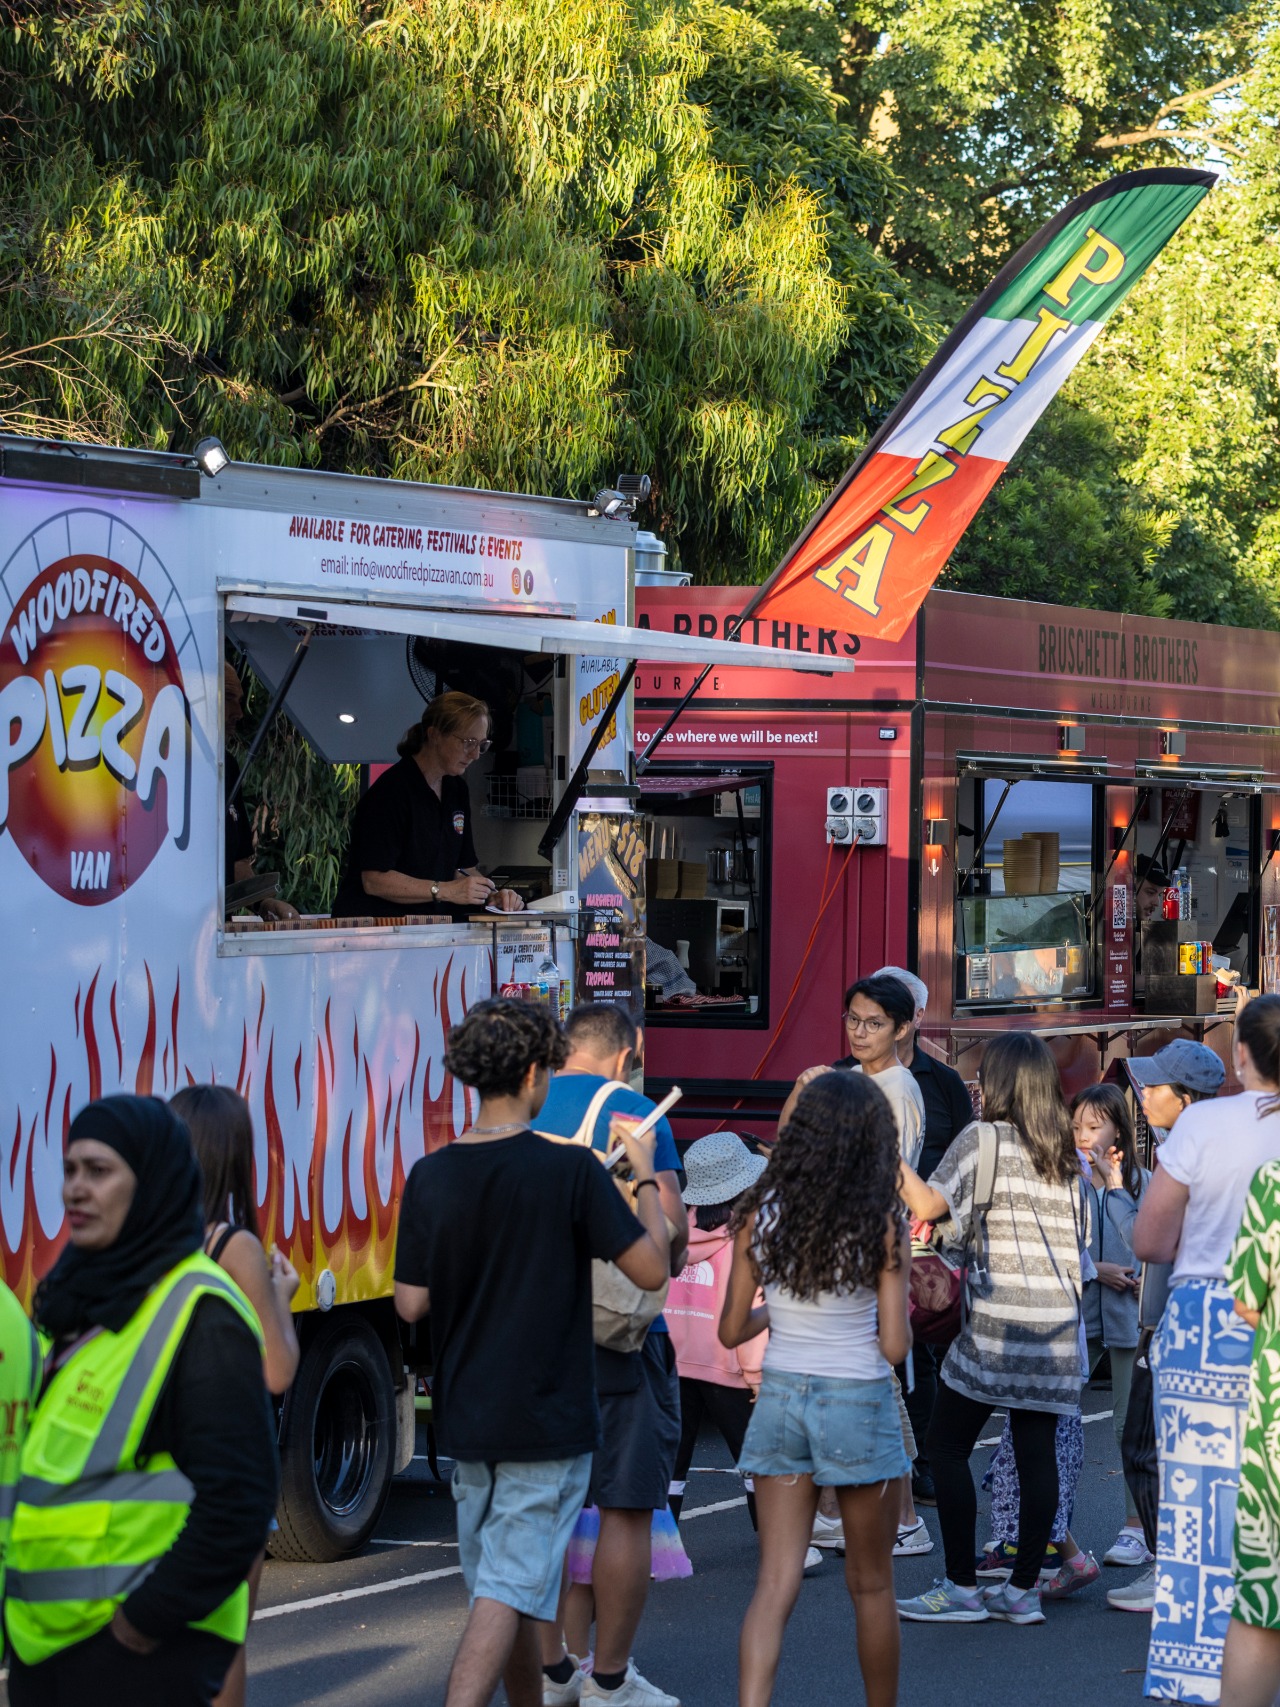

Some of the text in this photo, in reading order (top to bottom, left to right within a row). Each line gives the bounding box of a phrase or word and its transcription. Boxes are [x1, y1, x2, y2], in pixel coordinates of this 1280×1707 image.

[813, 224, 1128, 618] PIZZA
[288, 515, 523, 561] AVAILABLE FOR CATERING, FESTIVALS & EVENTS
[320, 555, 494, 588] email: info@woodfiredpizzavan.com.au
[10, 567, 166, 665] WOODFIRED
[295, 629, 336, 637] WTCH
[674, 613, 861, 655] BROTHERS
[580, 658, 619, 673] AVAILABLE
[1038, 624, 1199, 684] BRUSCHETTA BROTHERS
[579, 670, 621, 727] GLUTEN
[1091, 692, 1151, 712] MELBOURNE
[637, 731, 651, 743] to
[675, 730, 717, 743] where
[719, 733, 738, 743] we
[740, 730, 763, 743] will
[766, 730, 782, 743] be
[784, 731, 819, 744] next!
[0, 664, 190, 851] PIZZA
[578, 817, 646, 882] MENU $18
[70, 850, 111, 890] VAN
[586, 893, 623, 907] MARGHERITA
[586, 933, 620, 947] AMERICANA
[514, 954, 534, 963] ACCEPTED
[586, 972, 615, 987] TROPICAL
